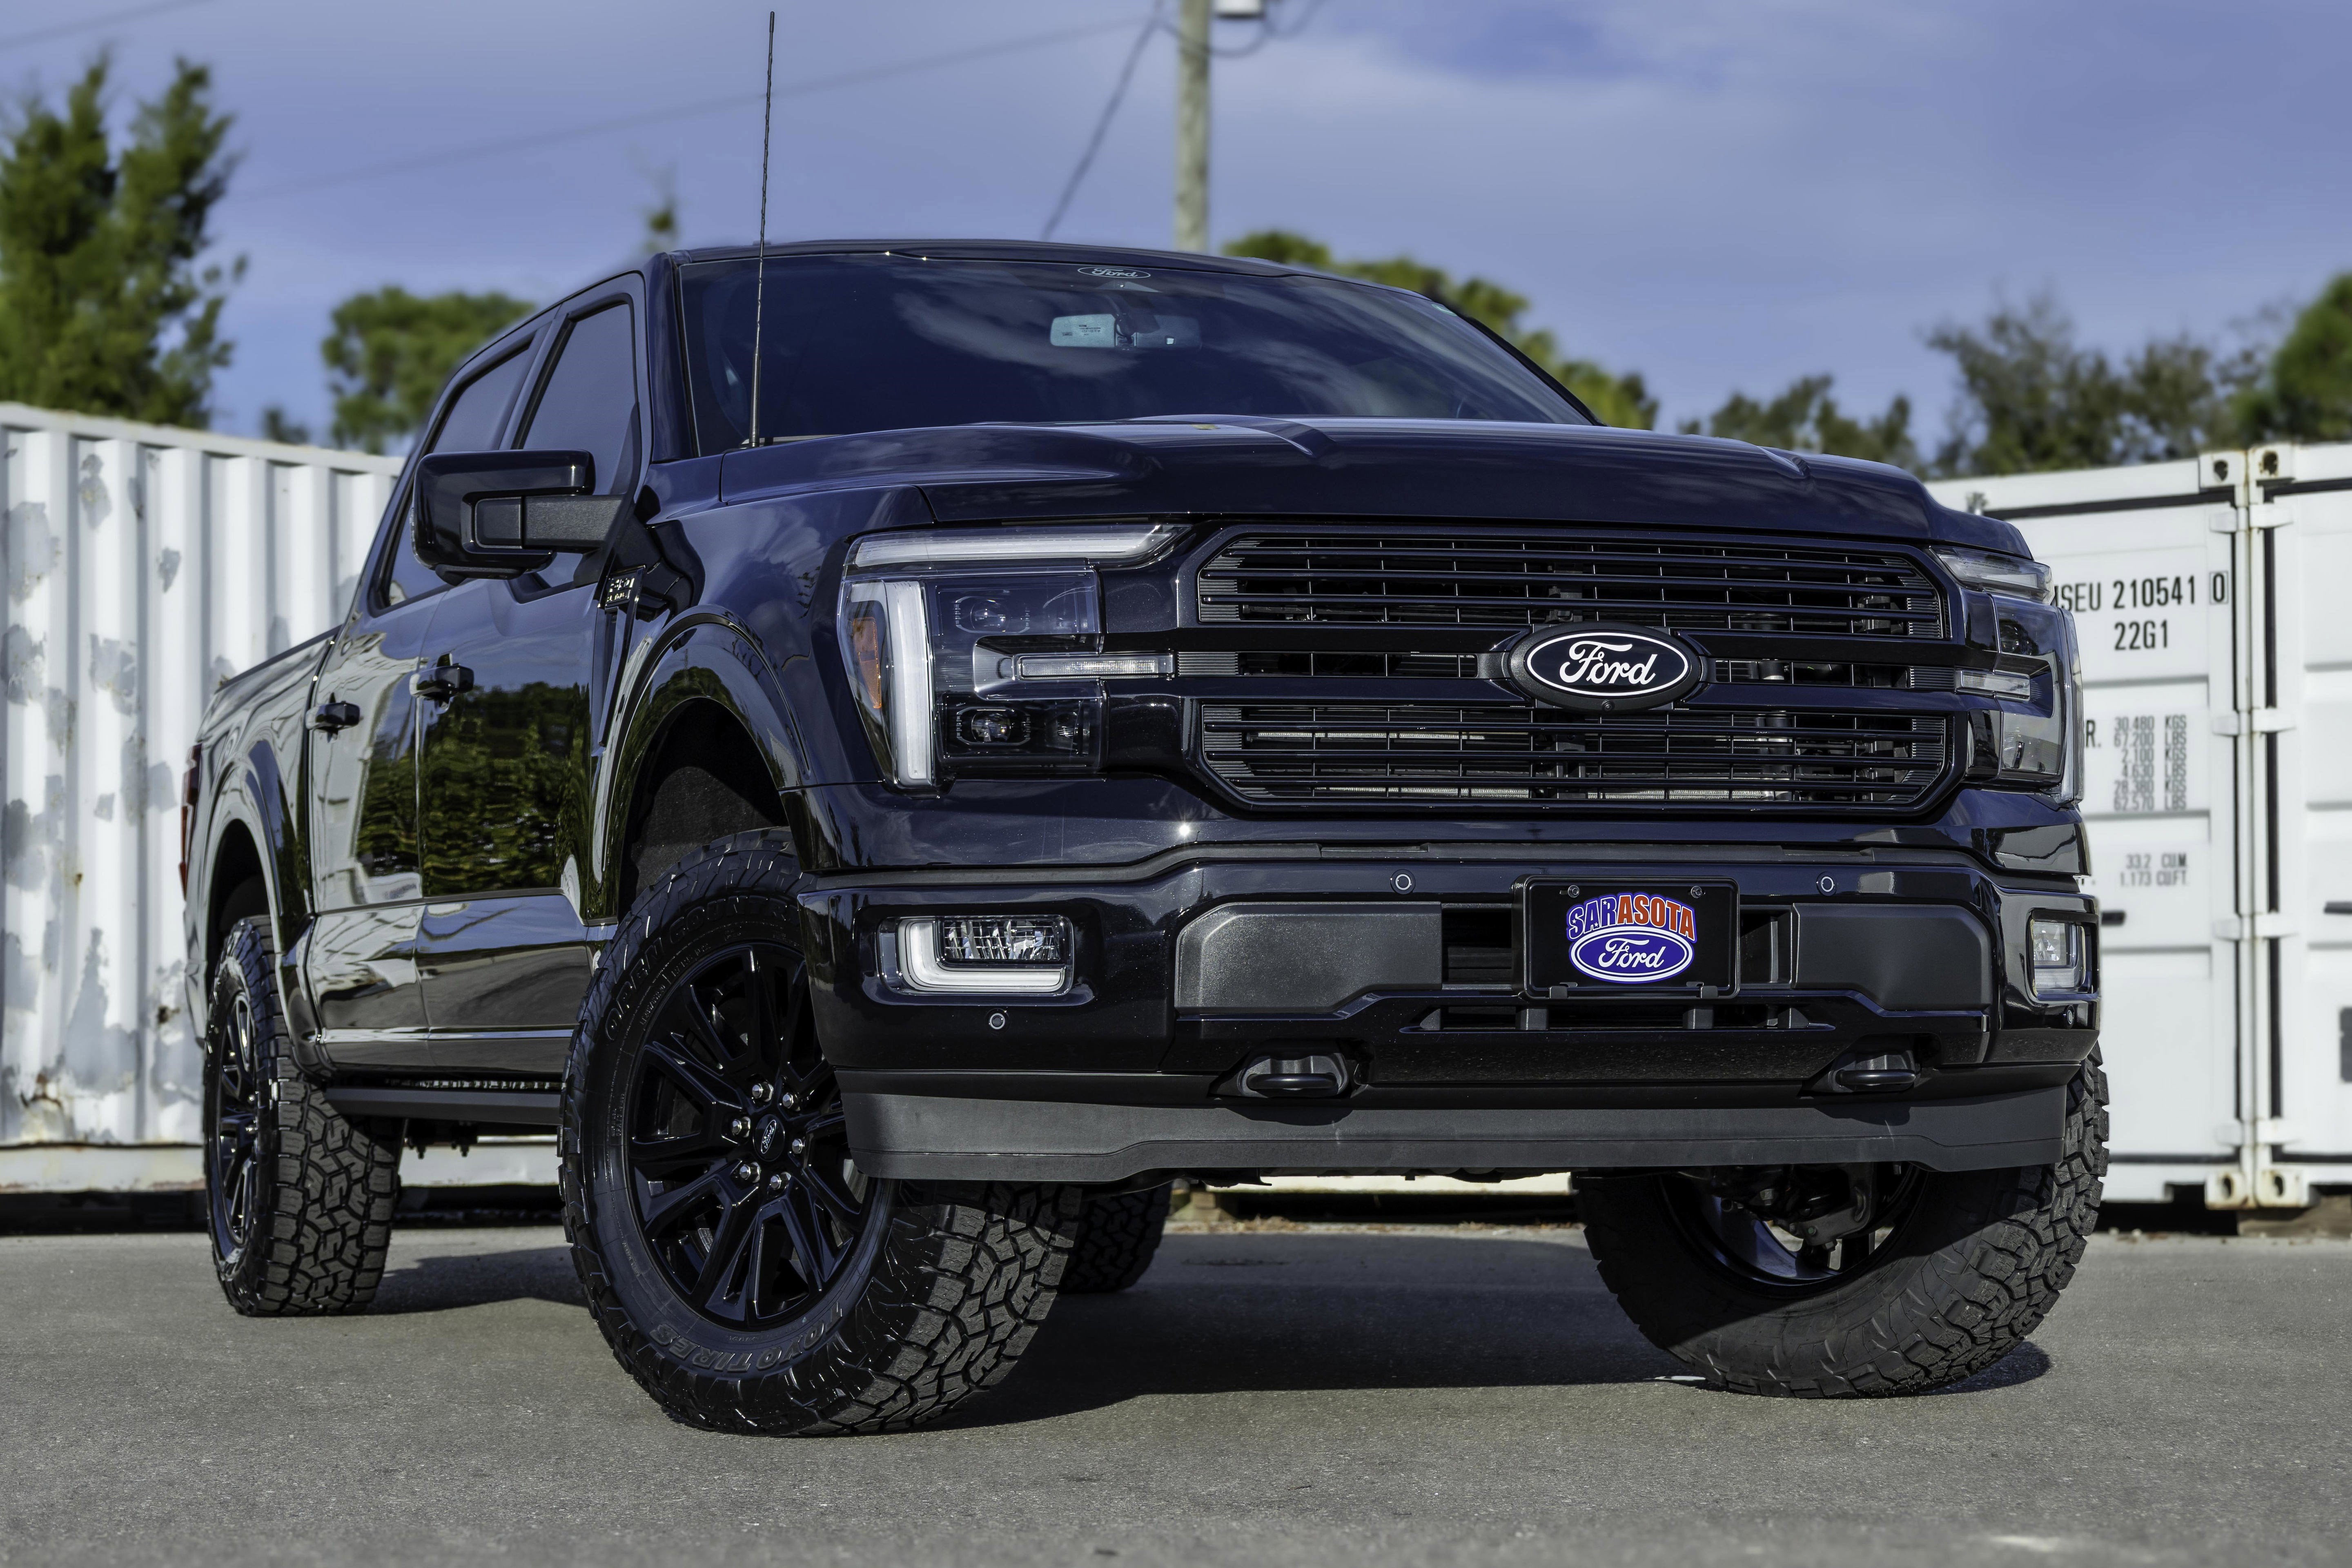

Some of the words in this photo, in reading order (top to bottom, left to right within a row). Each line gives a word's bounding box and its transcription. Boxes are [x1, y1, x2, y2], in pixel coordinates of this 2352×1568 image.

[1091, 267, 1138, 277] Ford
[2113, 575, 2196, 609] 210541
[2212, 573, 2226, 603] 0
[2114, 619, 2168, 651] 22G1
[1559, 641, 1658, 685] Ford
[2114, 716, 2154, 731] 30.480
[2165, 714, 2187, 729] KGS
[2165, 731, 2187, 746] LBS
[2165, 747, 2187, 762] KGS
[2165, 763, 2187, 777] LBS
[2165, 778, 2187, 793] KGS
[2165, 795, 2187, 810] LBS
[1568, 894, 1697, 942] SARASOTA
[1598, 938, 1666, 968] Ford
[605, 936, 665, 1042] OPEN
[648, 1322, 754, 1372] TIRES
[756, 1301, 843, 1370] TOYO
